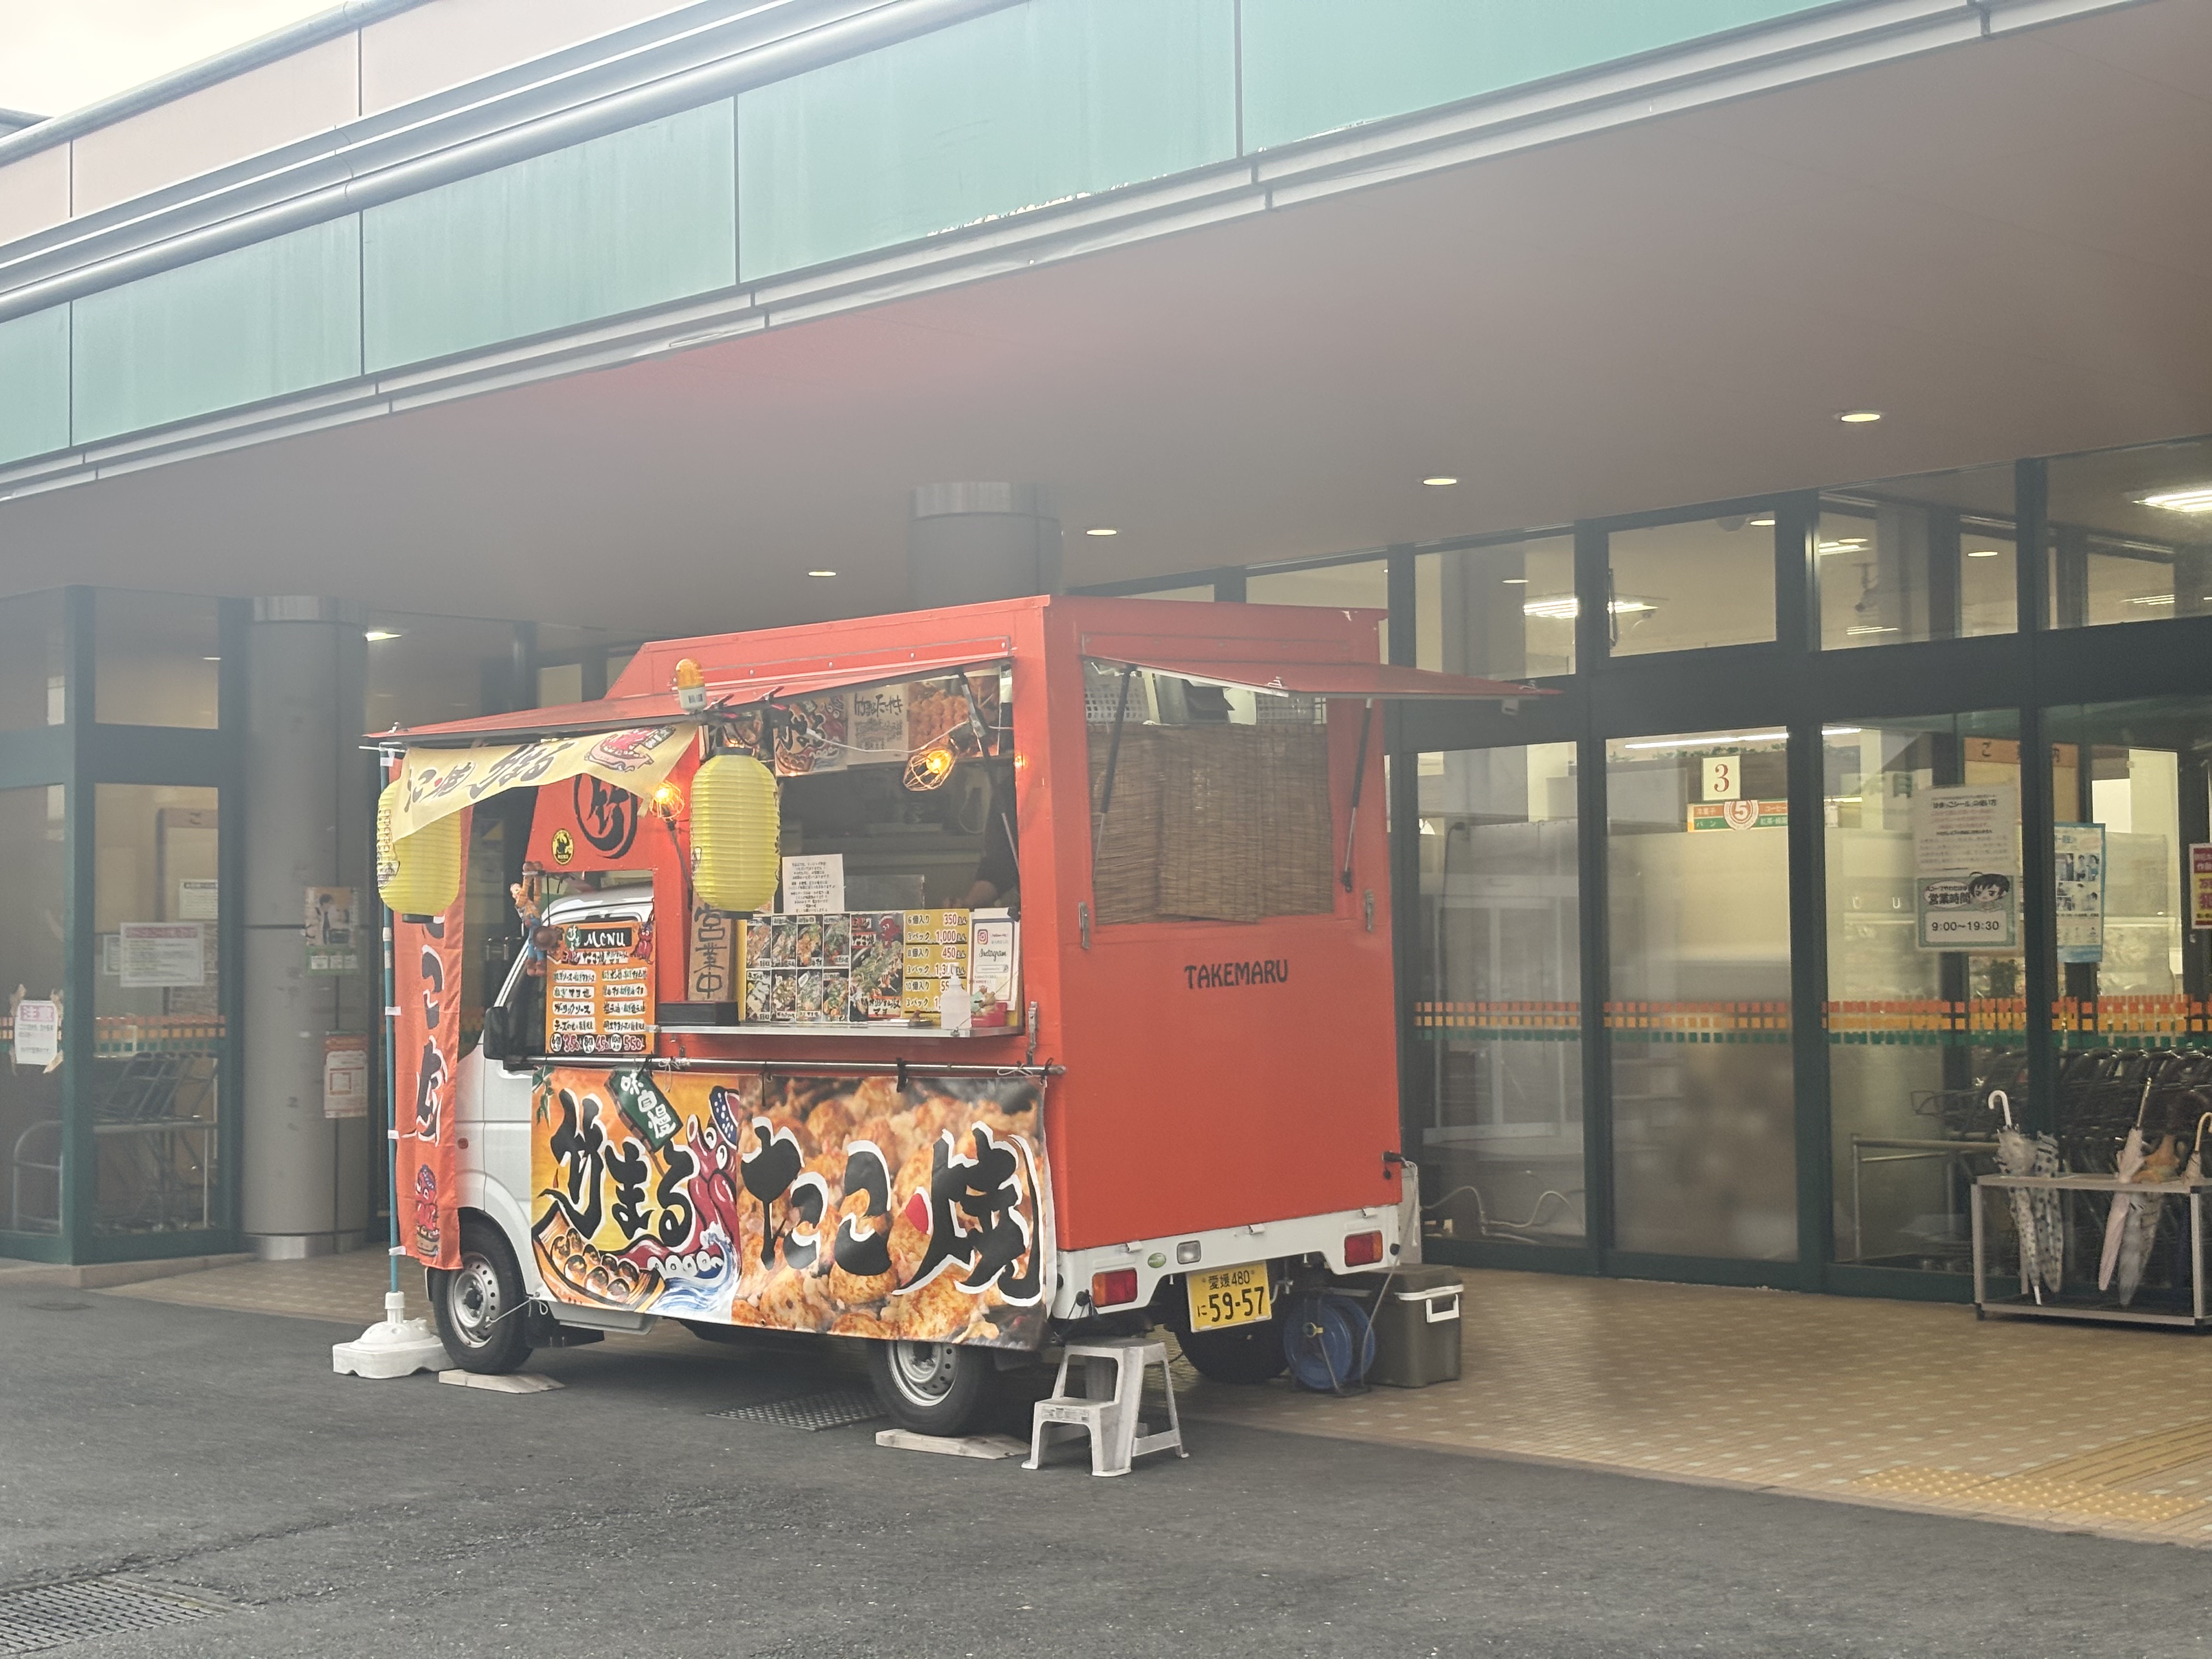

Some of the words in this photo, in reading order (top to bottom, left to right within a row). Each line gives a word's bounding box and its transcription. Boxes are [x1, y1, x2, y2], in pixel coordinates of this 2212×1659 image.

[1714, 764, 1729, 792] 3
[1735, 800, 1748, 821] 5
[1928, 892, 1971, 905] 営業時間
[907, 914, 930, 925] 6個入り
[979, 948, 1007, 962] Instagram
[1183, 959, 1289, 990] TAKEMARU
[620, 1071, 676, 1139] 味自慢
[740, 1116, 1043, 1307] たこ焼
[1209, 1286, 1264, 1323] 59-57
